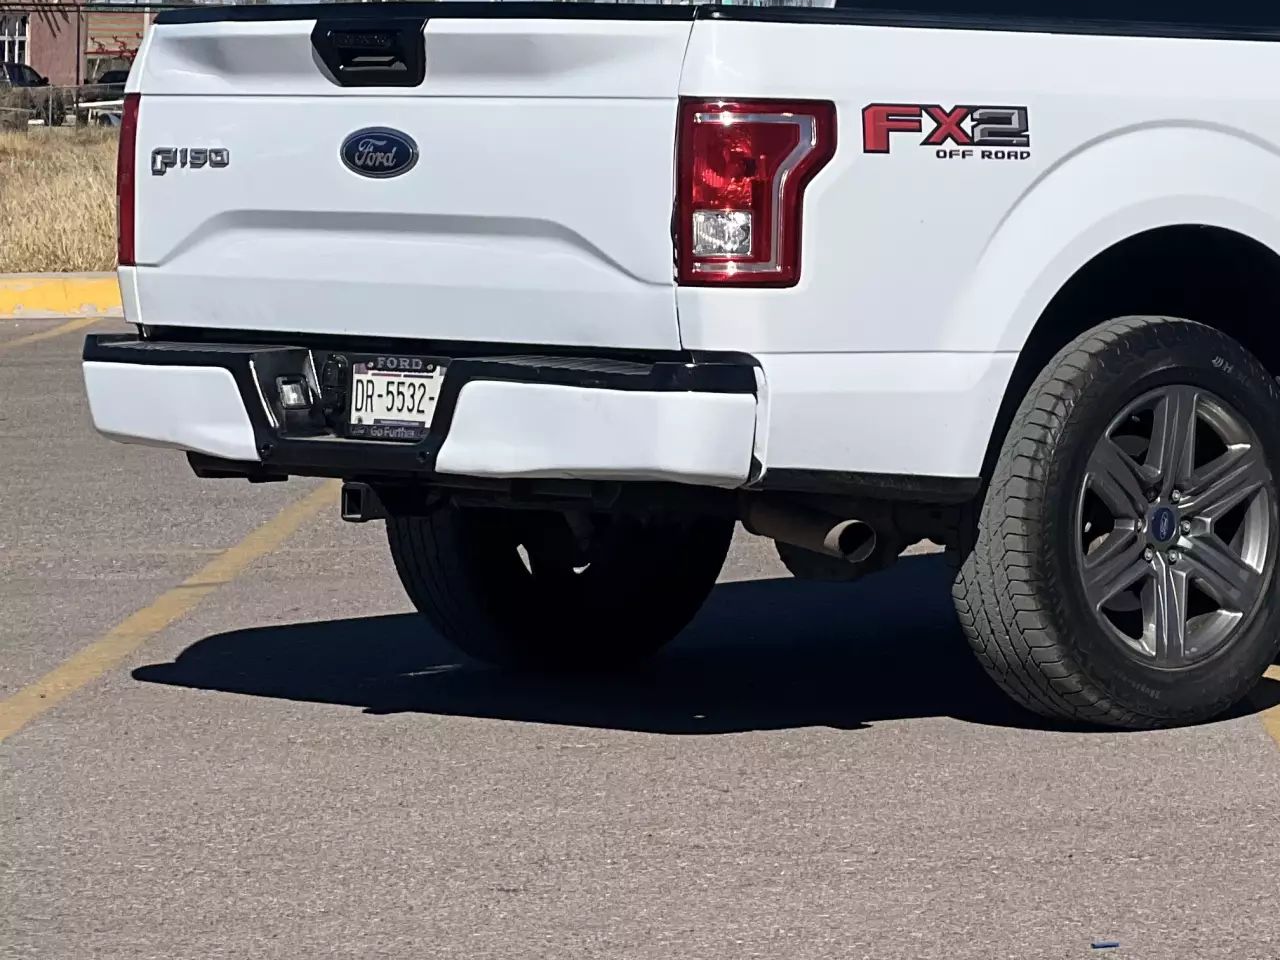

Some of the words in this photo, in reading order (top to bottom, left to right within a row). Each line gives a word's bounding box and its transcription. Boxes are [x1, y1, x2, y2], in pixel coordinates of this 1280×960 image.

[862, 103, 1031, 154] FX2
[151, 147, 230, 176] F150
[354, 138, 397, 168] Ford
[935, 149, 974, 160] OFF
[980, 149, 1031, 161] ROAD
[376, 357, 423, 370] FORD
[370, 426, 383, 437] Go
